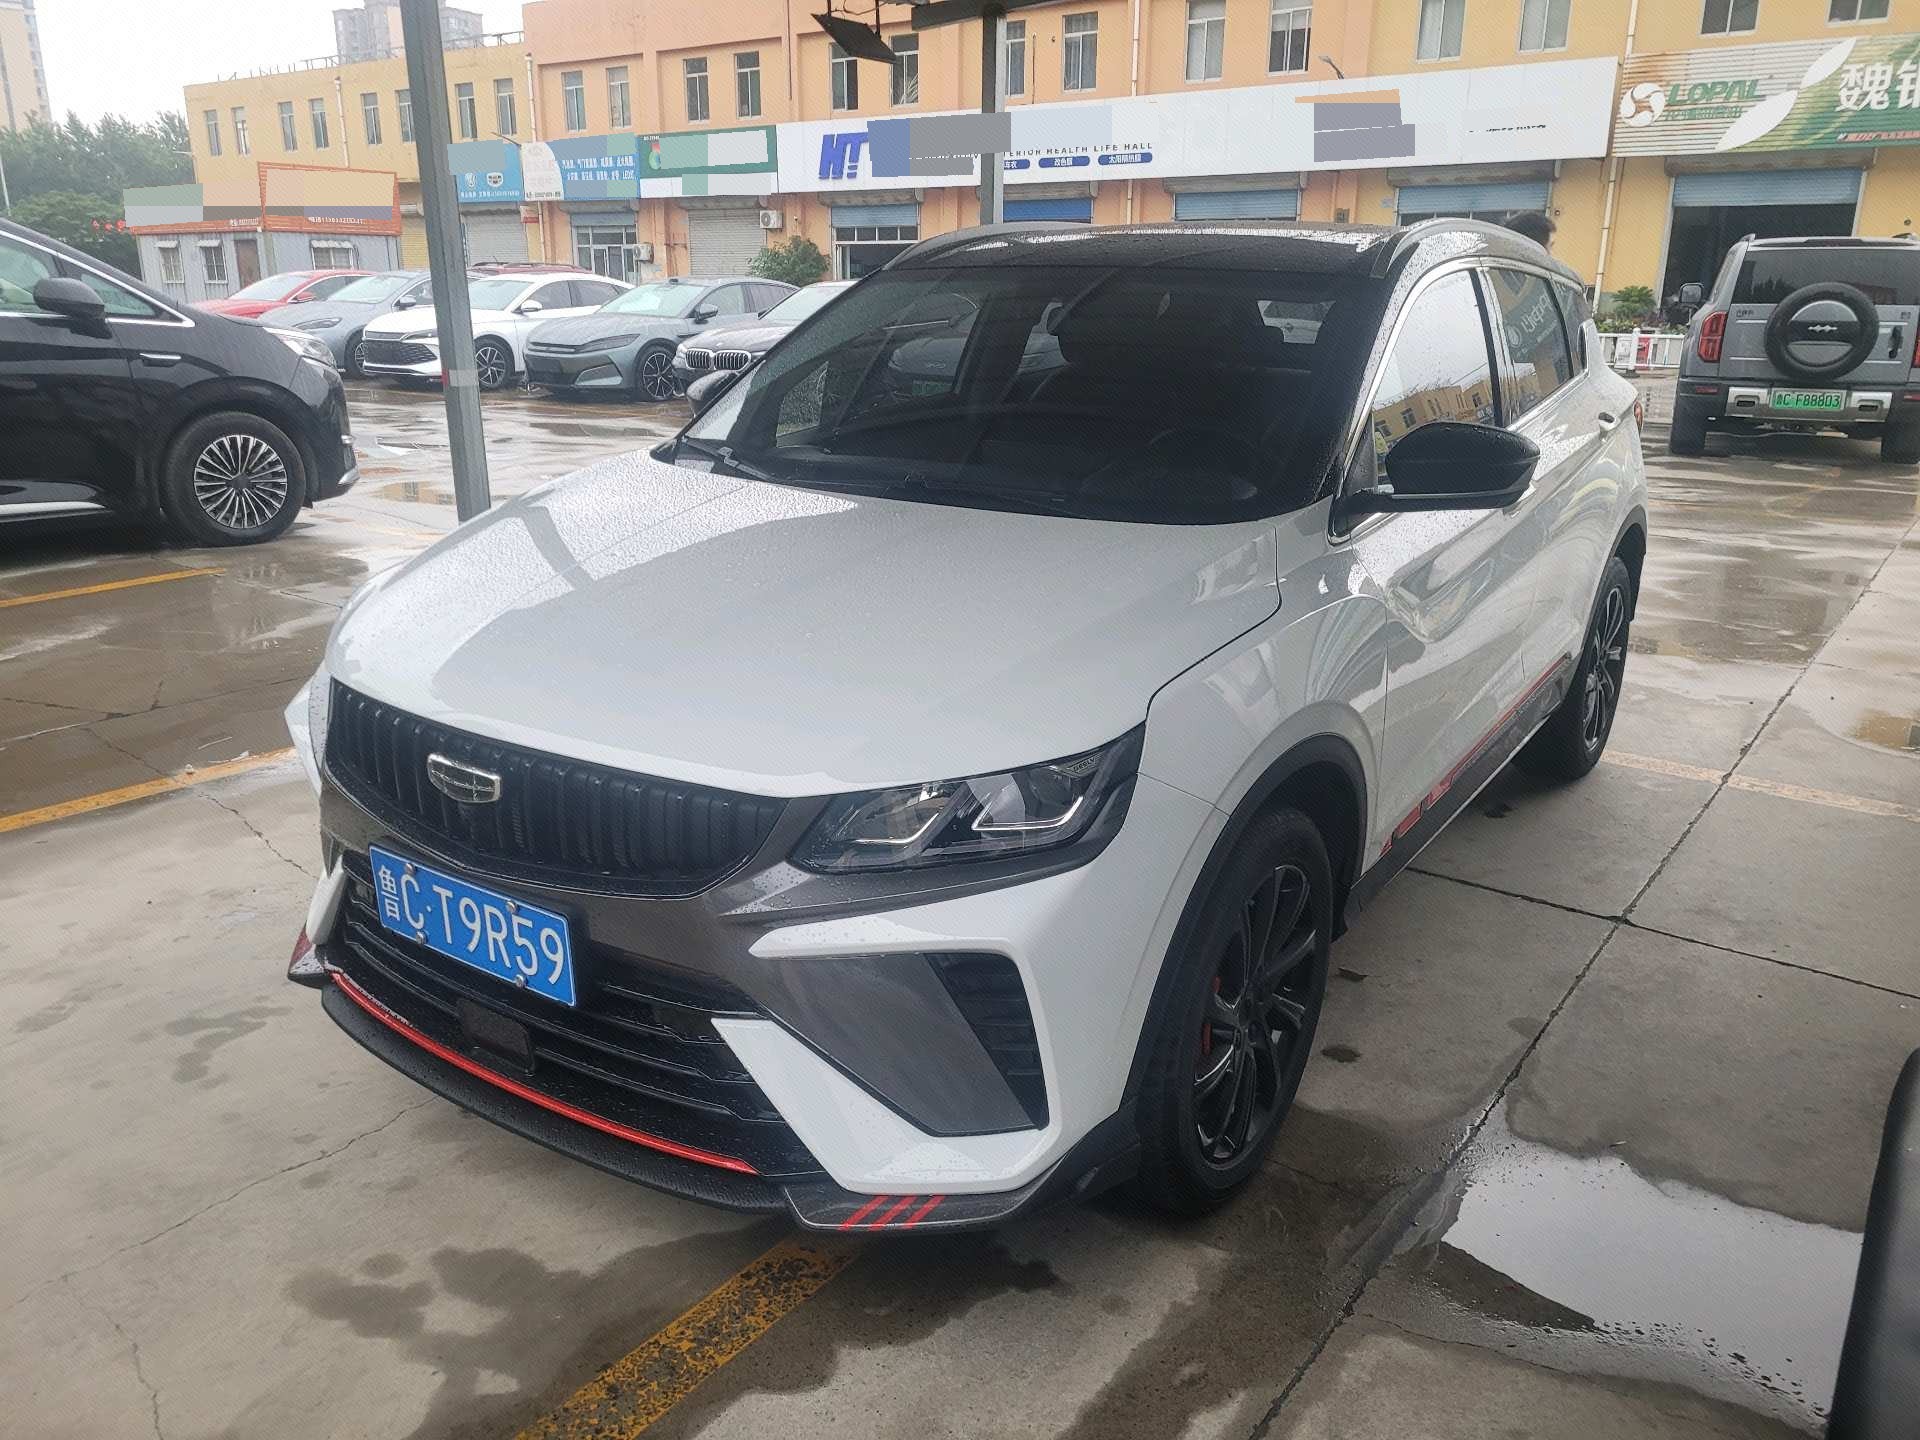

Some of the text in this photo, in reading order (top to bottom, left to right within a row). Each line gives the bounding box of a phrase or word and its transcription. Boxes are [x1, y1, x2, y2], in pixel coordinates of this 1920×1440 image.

[1666, 79, 1767, 106] LOPAL
[1046, 146, 1088, 155] HEALTH
[1093, 144, 1119, 152] LIFE
[1124, 142, 1153, 151] HALL
